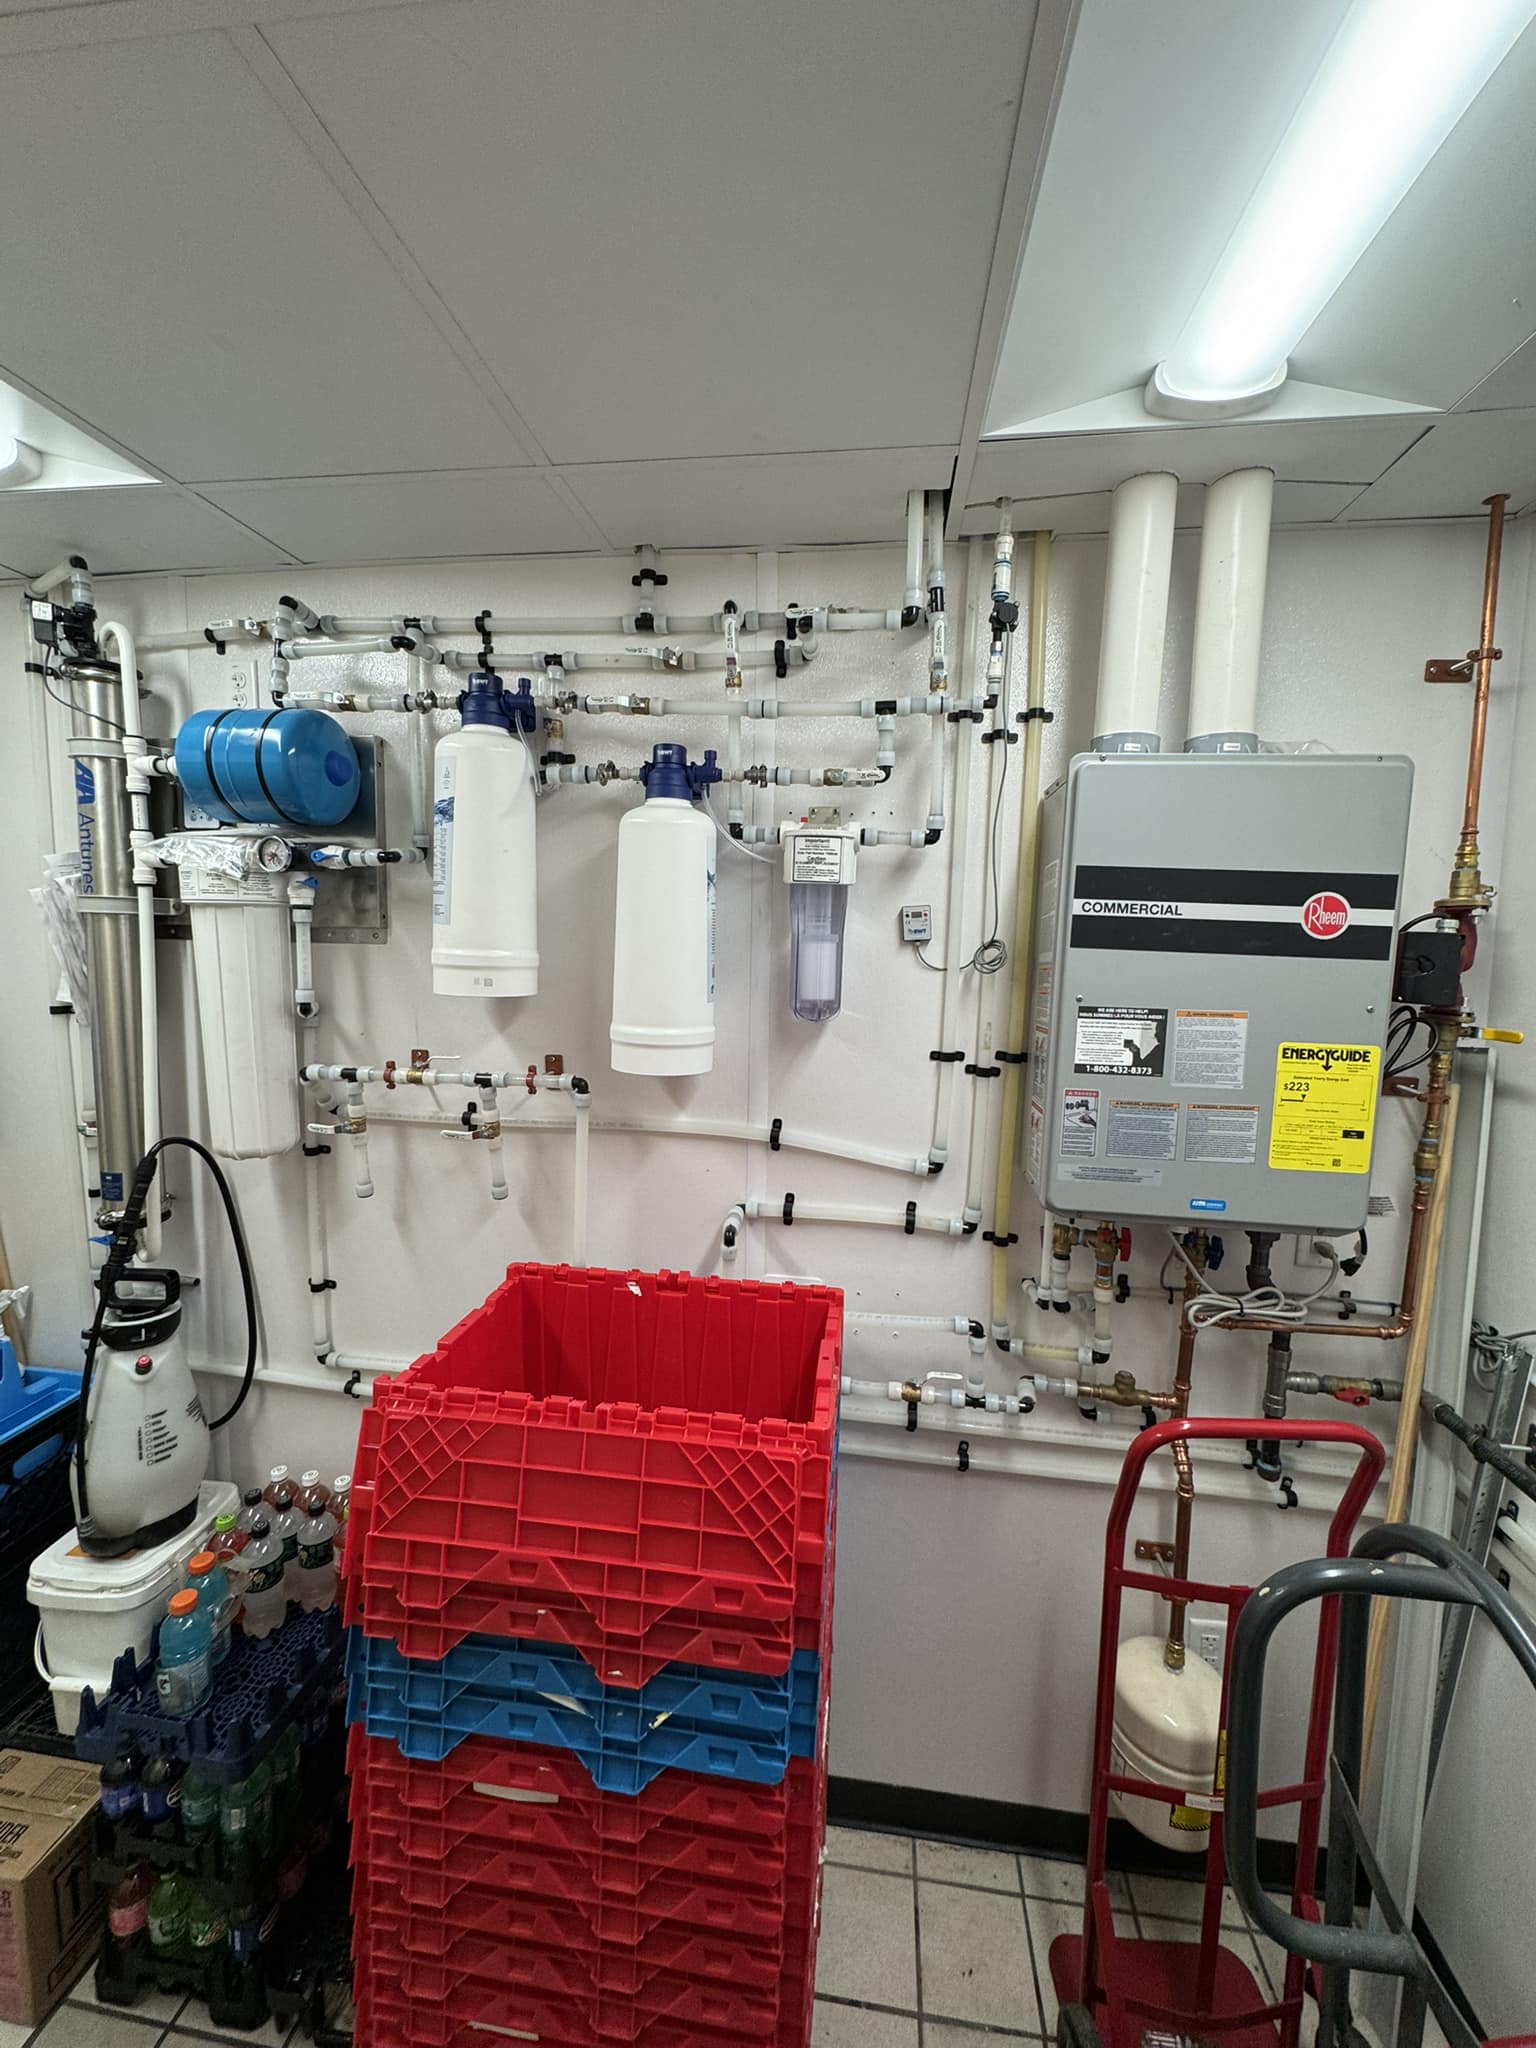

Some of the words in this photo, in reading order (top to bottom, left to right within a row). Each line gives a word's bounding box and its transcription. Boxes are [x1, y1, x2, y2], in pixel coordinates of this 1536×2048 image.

[79, 812, 95, 894] Antunes
[1081, 901, 1183, 917] COMMERCIAL
[1308, 896, 1346, 930] Rheem
[1281, 1047, 1371, 1062] ENERGYGUIDE
[1086, 1065, 1152, 1075] 1-800-432-8373
[1283, 1081, 1310, 1092] $223
